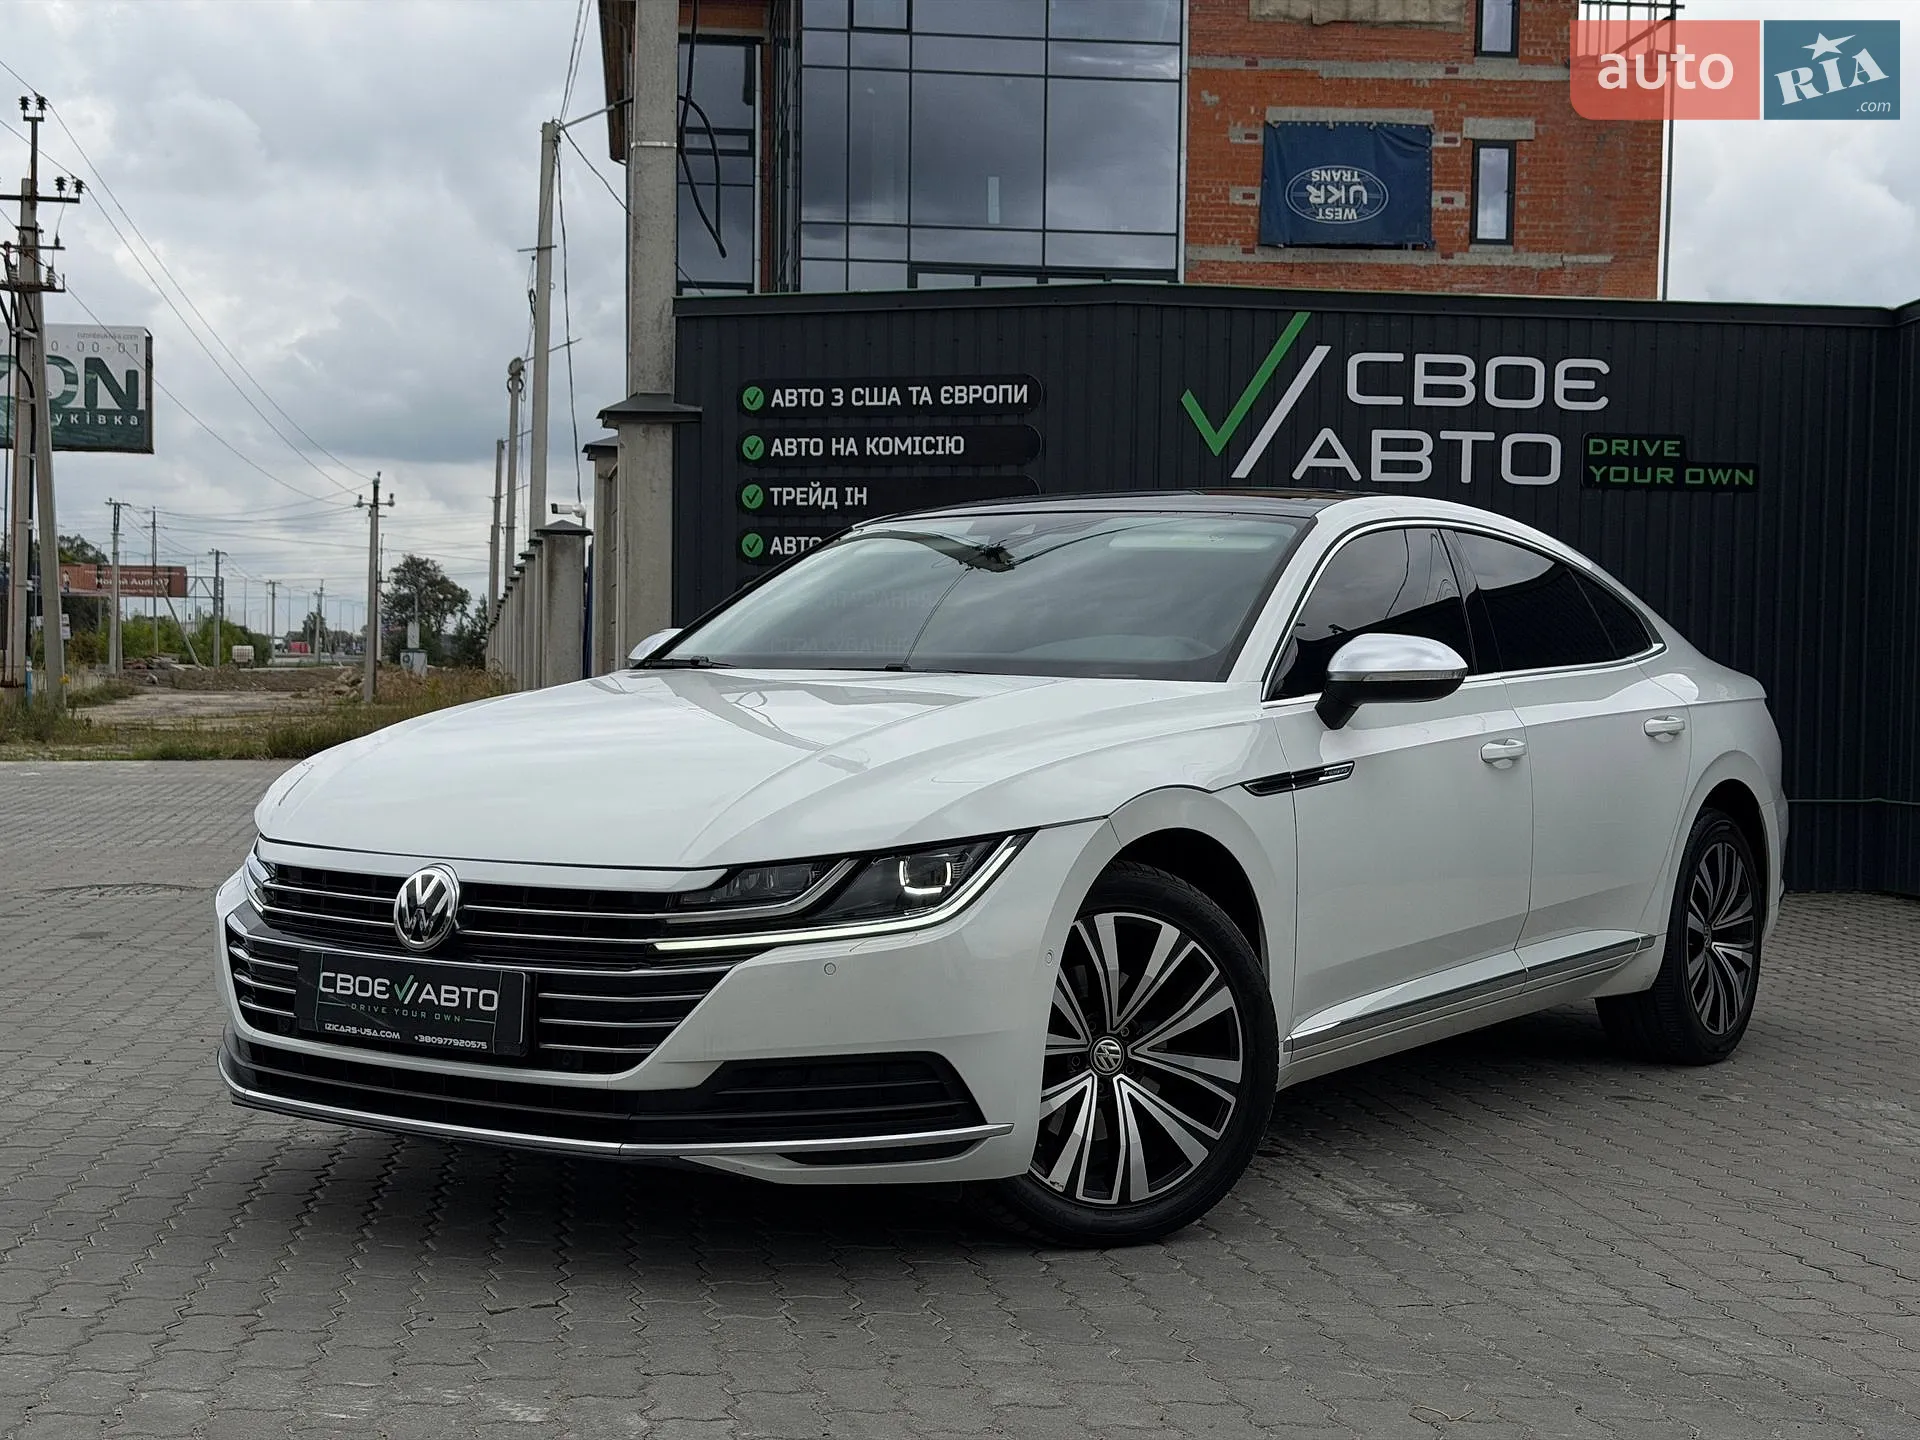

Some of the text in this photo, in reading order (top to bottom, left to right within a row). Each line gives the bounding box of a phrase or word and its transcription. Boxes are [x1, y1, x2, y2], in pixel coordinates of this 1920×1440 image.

[1311, 169, 1361, 182] TRANS
[1306, 184, 1368, 205] UKR
[1316, 207, 1358, 220] WEST
[1346, 352, 1611, 411] СВОЄ
[770, 384, 1029, 408] АВТО З США ТА ЄВРОПИ
[55, 411, 139, 425] уківка
[770, 435, 965, 457] АВТО НА КОМІСІЮ
[1291, 427, 1562, 486] АВТО
[1588, 438, 1681, 458] DRIVE
[1588, 465, 1755, 486] YOUR OWN
[769, 482, 868, 510] ТРЕЙД ІН
[319, 971, 499, 1012] СВОЄ АВТО
[350, 1002, 462, 1023] DRIVE YOUR OWN
